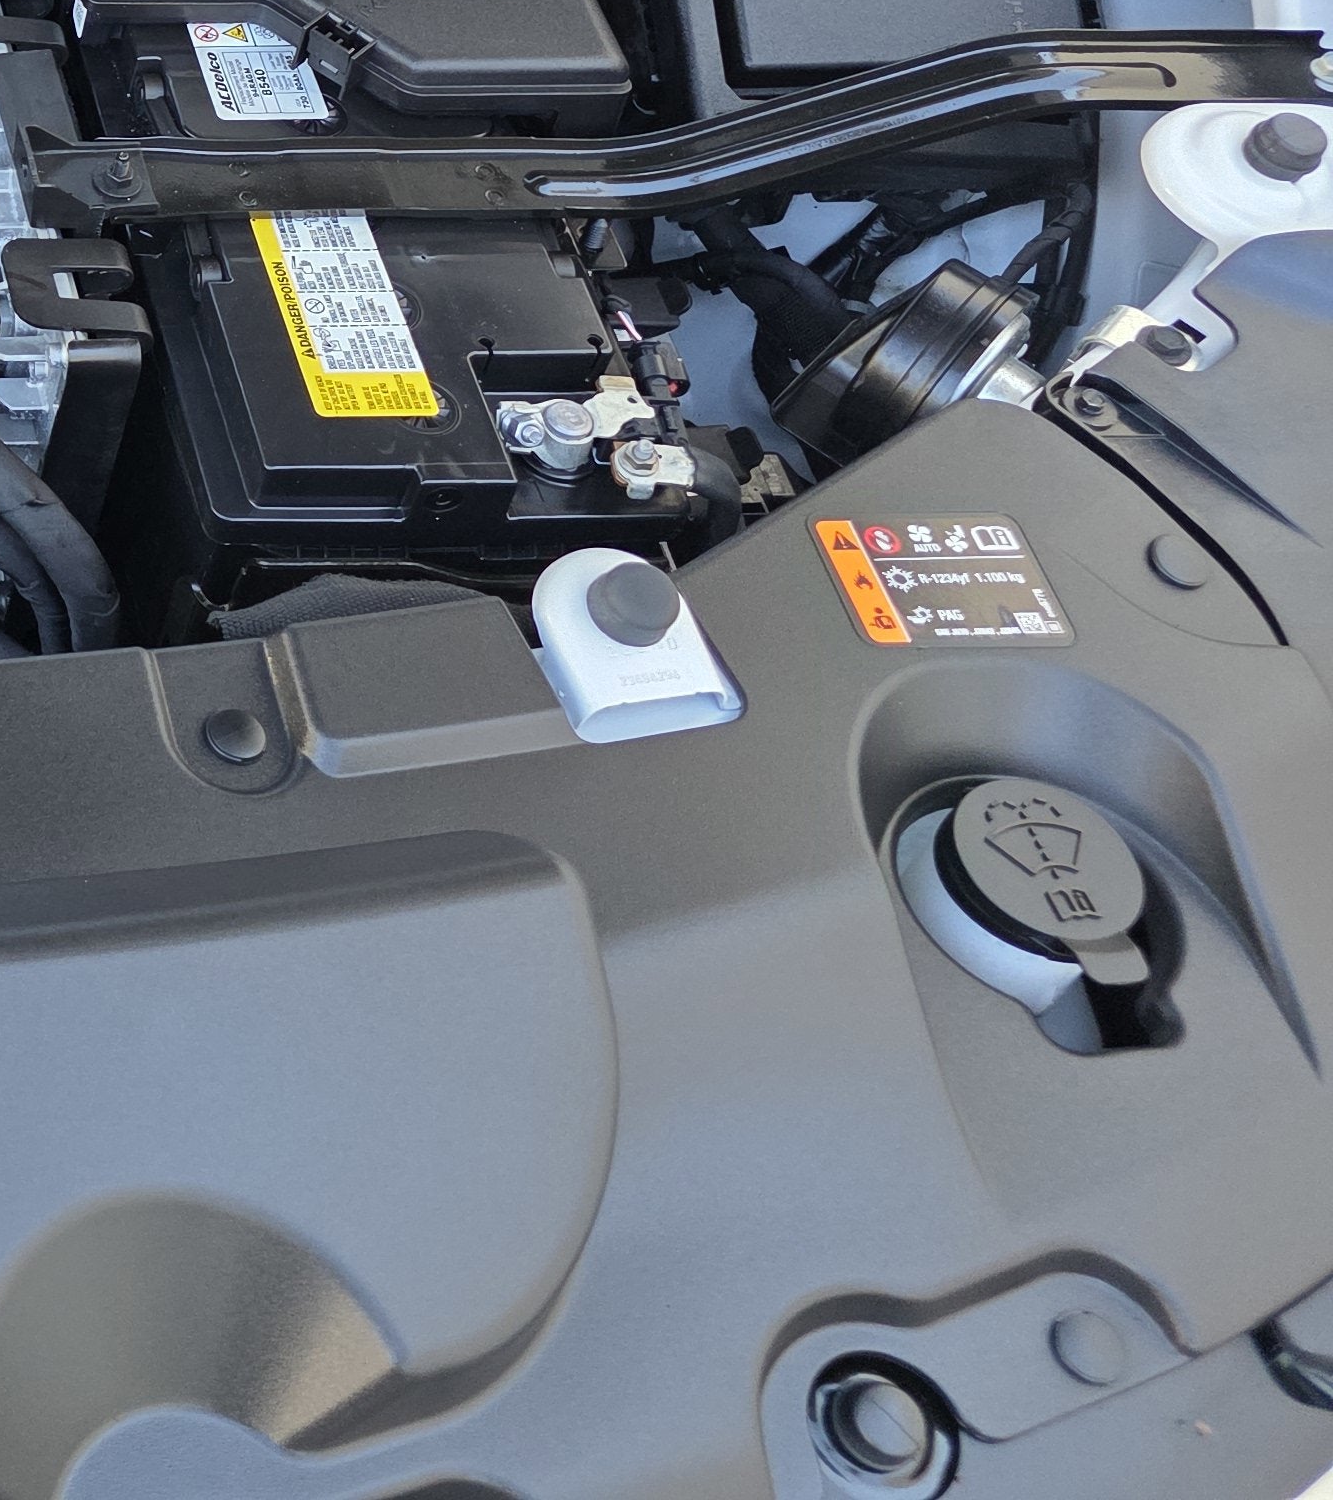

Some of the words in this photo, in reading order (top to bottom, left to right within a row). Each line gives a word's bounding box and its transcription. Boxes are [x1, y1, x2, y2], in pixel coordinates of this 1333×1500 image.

[206, 51, 235, 111] ACDelco
[253, 68, 272, 95] 8540
[271, 261, 312, 347] DANGER/POISON
[913, 544, 941, 553] AUTO
[917, 572, 969, 585] R-1234yf
[974, 572, 1008, 583] 1.100
[1008, 572, 1026, 584] kg
[936, 609, 965, 621] PAG
